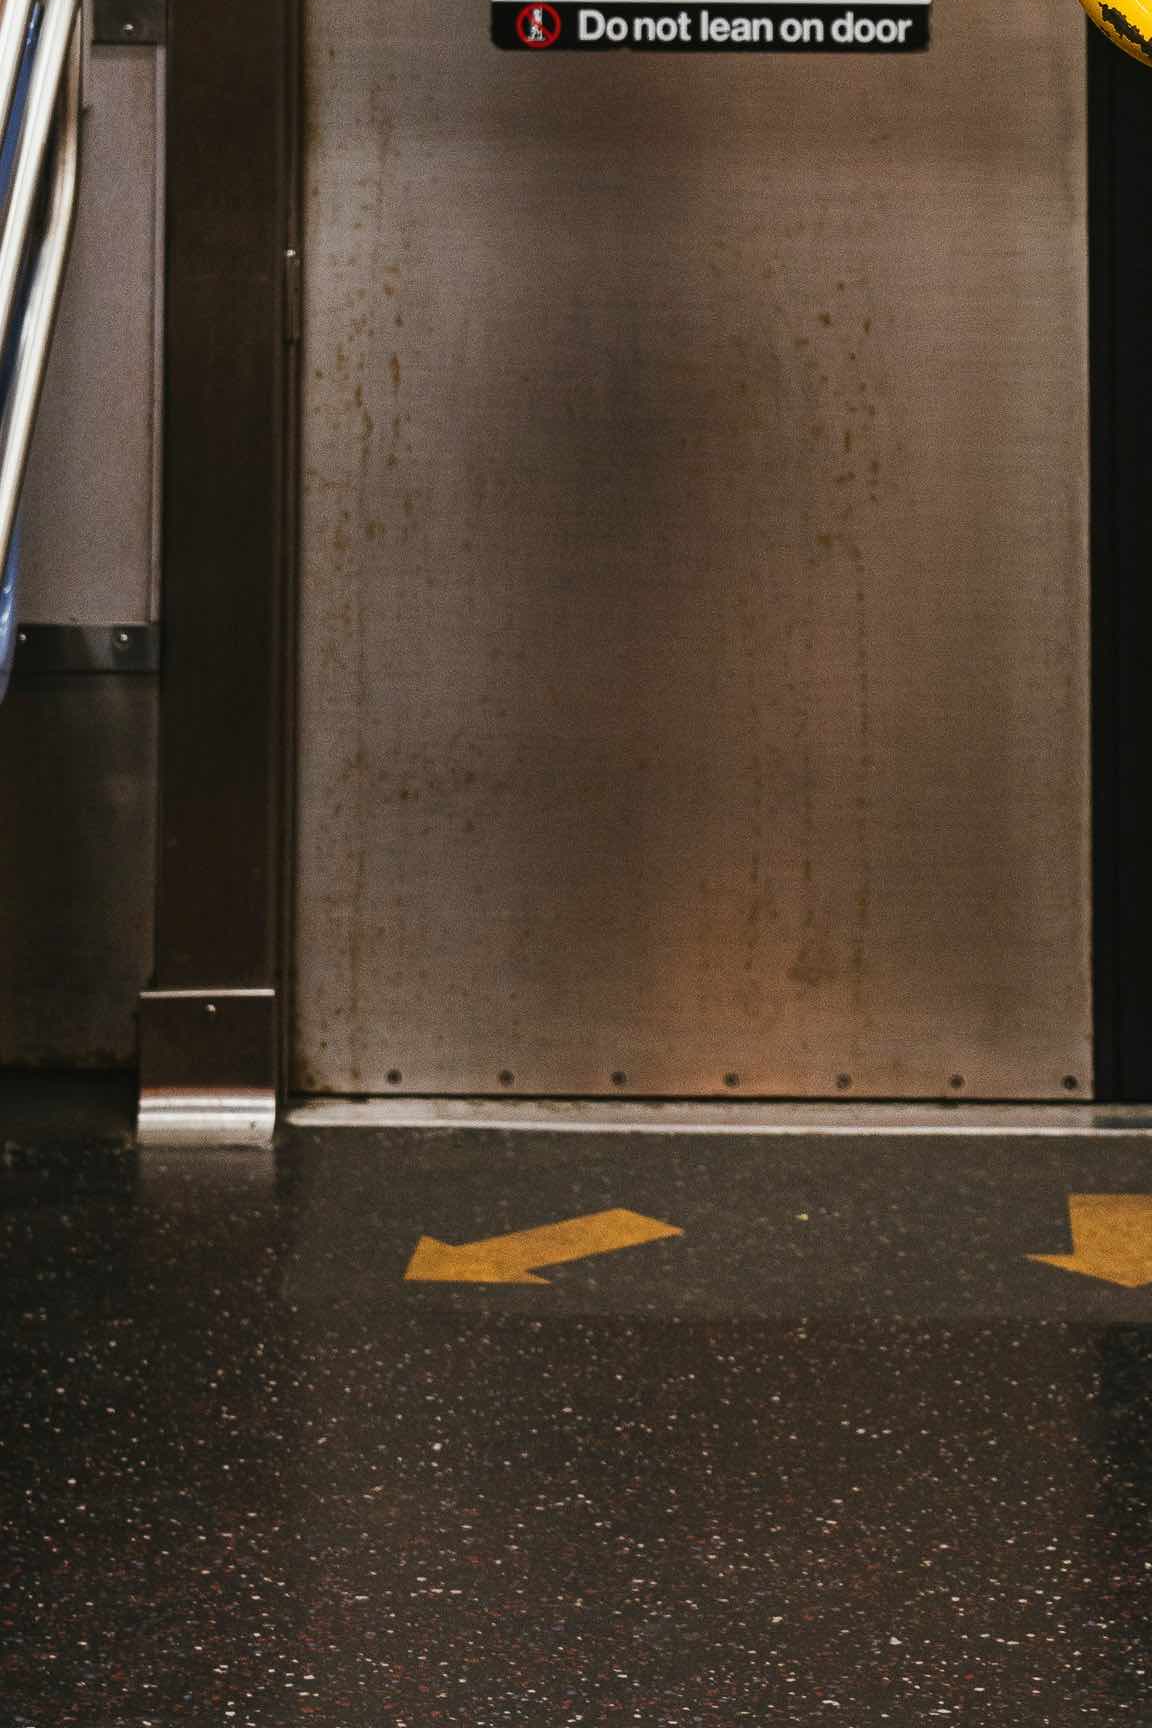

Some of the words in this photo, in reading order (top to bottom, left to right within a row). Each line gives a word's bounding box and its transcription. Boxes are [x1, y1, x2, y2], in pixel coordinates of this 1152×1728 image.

[578, 9, 629, 41] Do
[633, 11, 692, 42] not
[700, 10, 774, 42] lean
[779, 18, 824, 43] on
[831, 11, 913, 43] door
